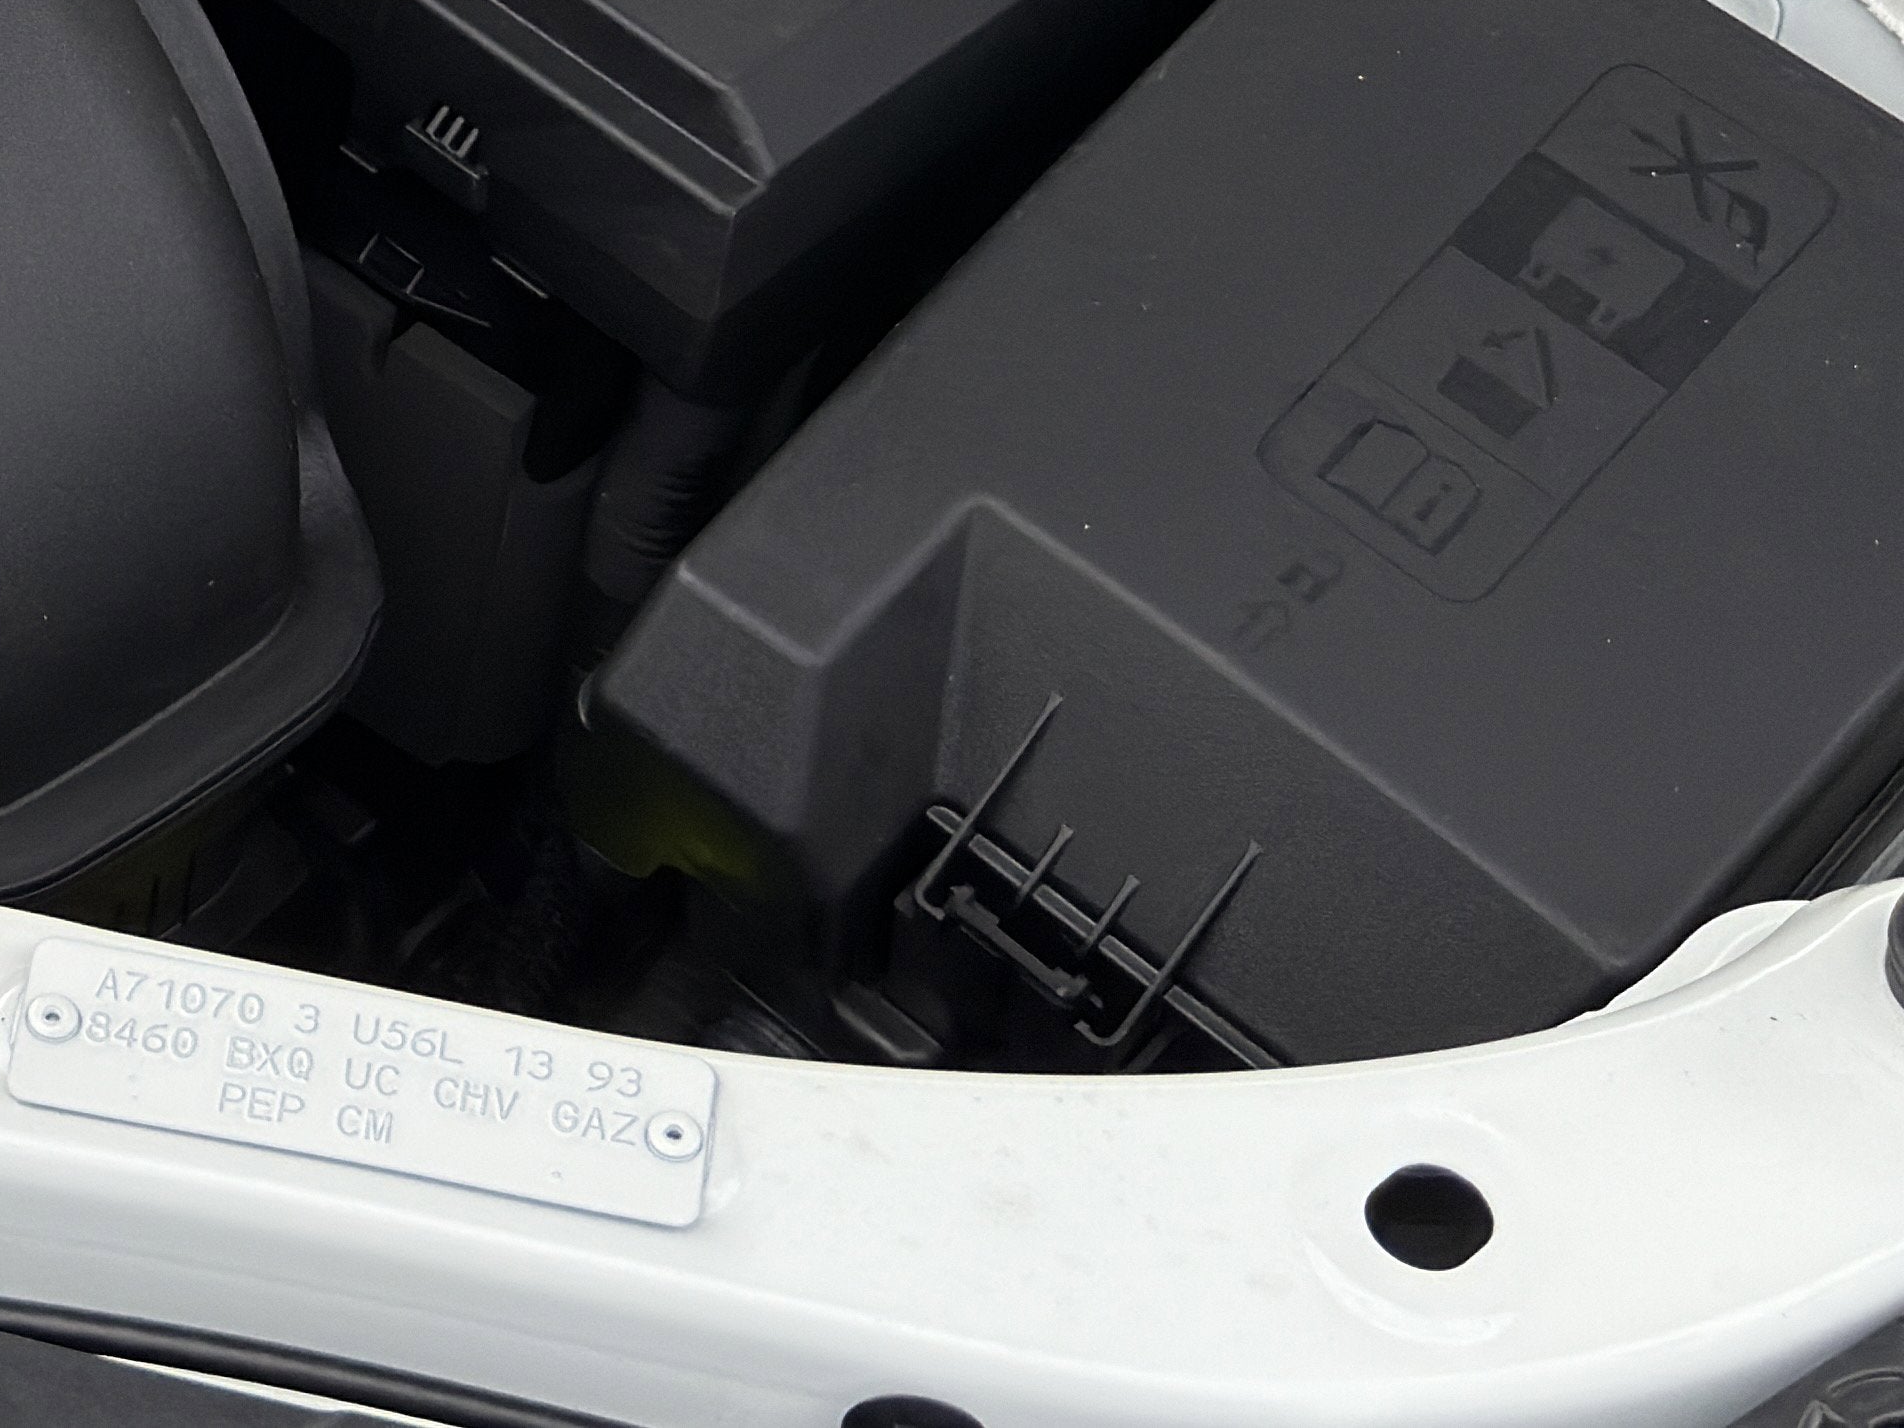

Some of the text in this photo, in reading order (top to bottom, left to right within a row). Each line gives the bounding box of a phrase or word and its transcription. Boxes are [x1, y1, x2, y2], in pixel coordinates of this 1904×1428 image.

[85, 1013, 642, 1148] 8460 BXQ UC CHV GAZ
[95, 967, 644, 1100] A71070 3 U56L 13 93
[216, 1084, 395, 1145] PEP CM
